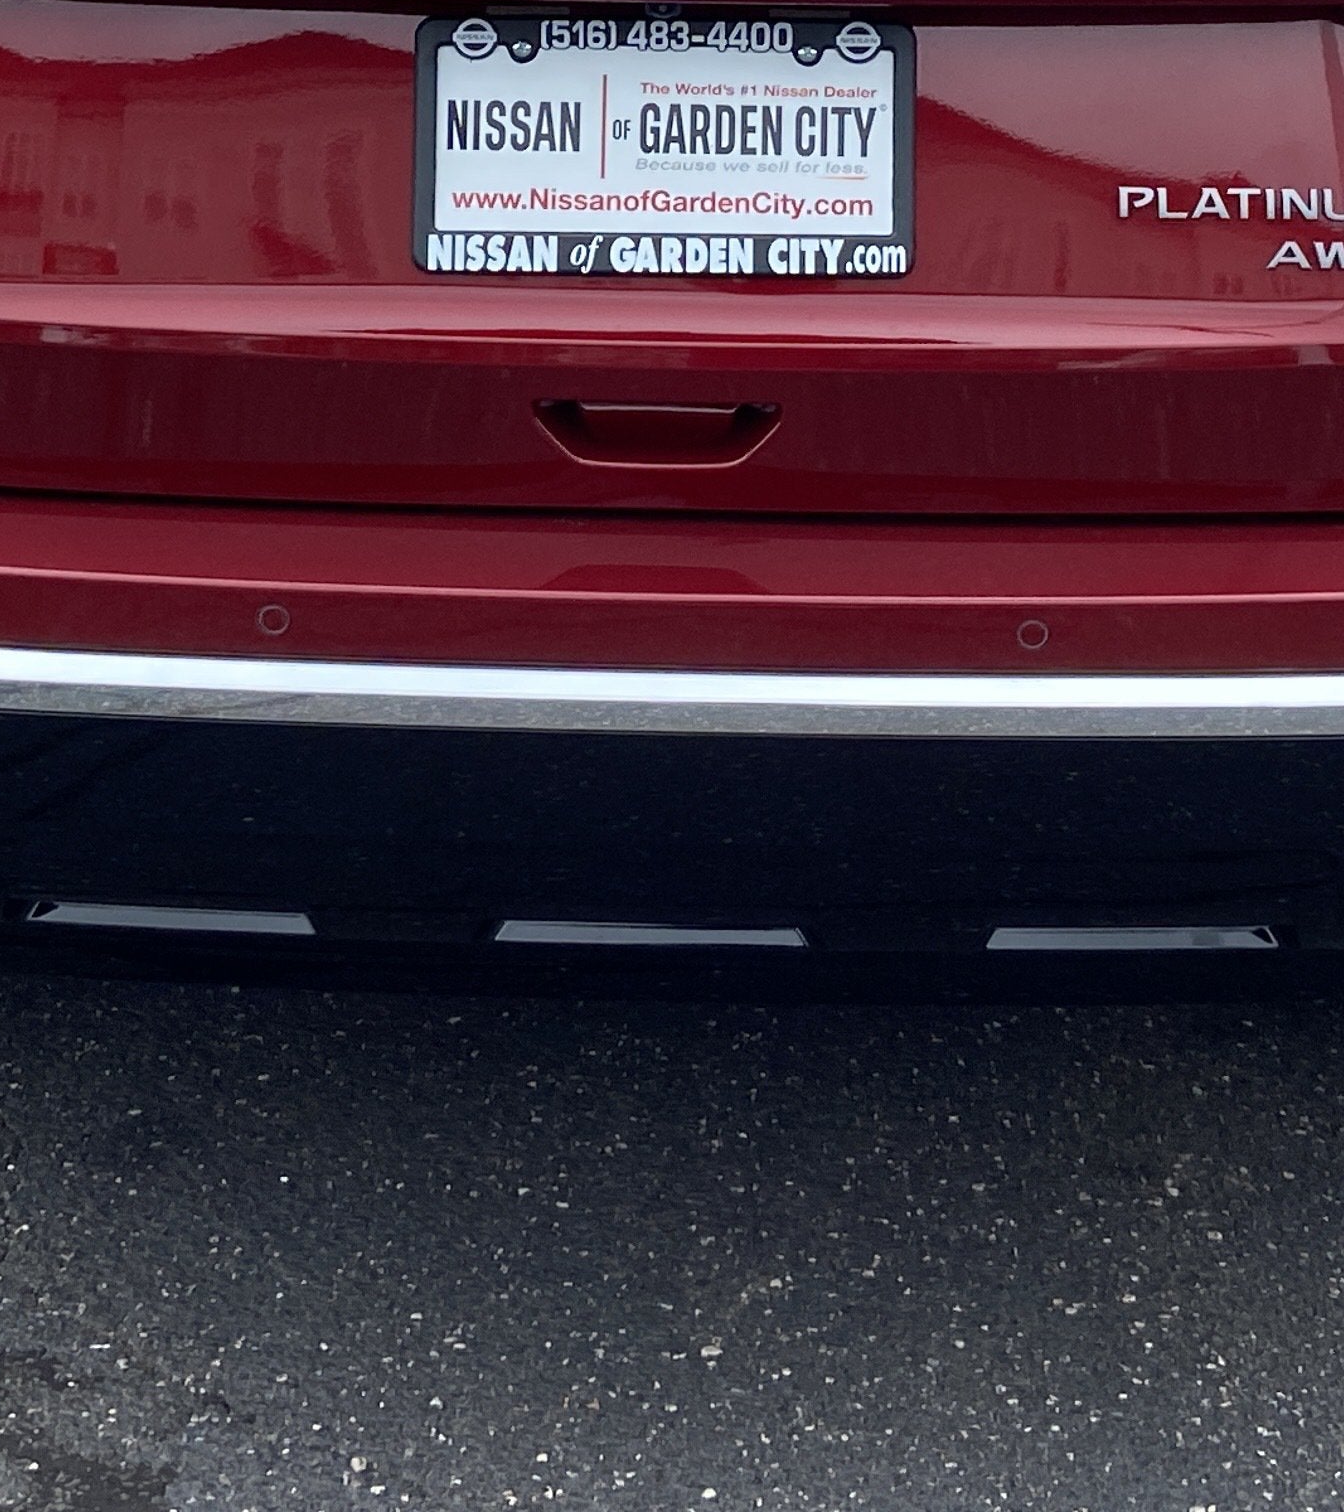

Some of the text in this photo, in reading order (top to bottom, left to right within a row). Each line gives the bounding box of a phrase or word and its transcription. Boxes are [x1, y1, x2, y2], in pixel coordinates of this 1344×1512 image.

[540, 21, 794, 53] (516) 483-4400
[640, 82, 878, 99] The World's #1 Nissan Dealer
[446, 99, 582, 153] NISSAN
[612, 103, 877, 158] OF GARDEN CITY
[635, 158, 716, 172] Because
[722, 161, 750, 173] we
[756, 161, 788, 173] sell
[794, 161, 820, 174] for
[452, 188, 874, 219] www.NissanofGardenCity.com
[427, 234, 907, 275] NISSAN of GARDEN CITY.com
